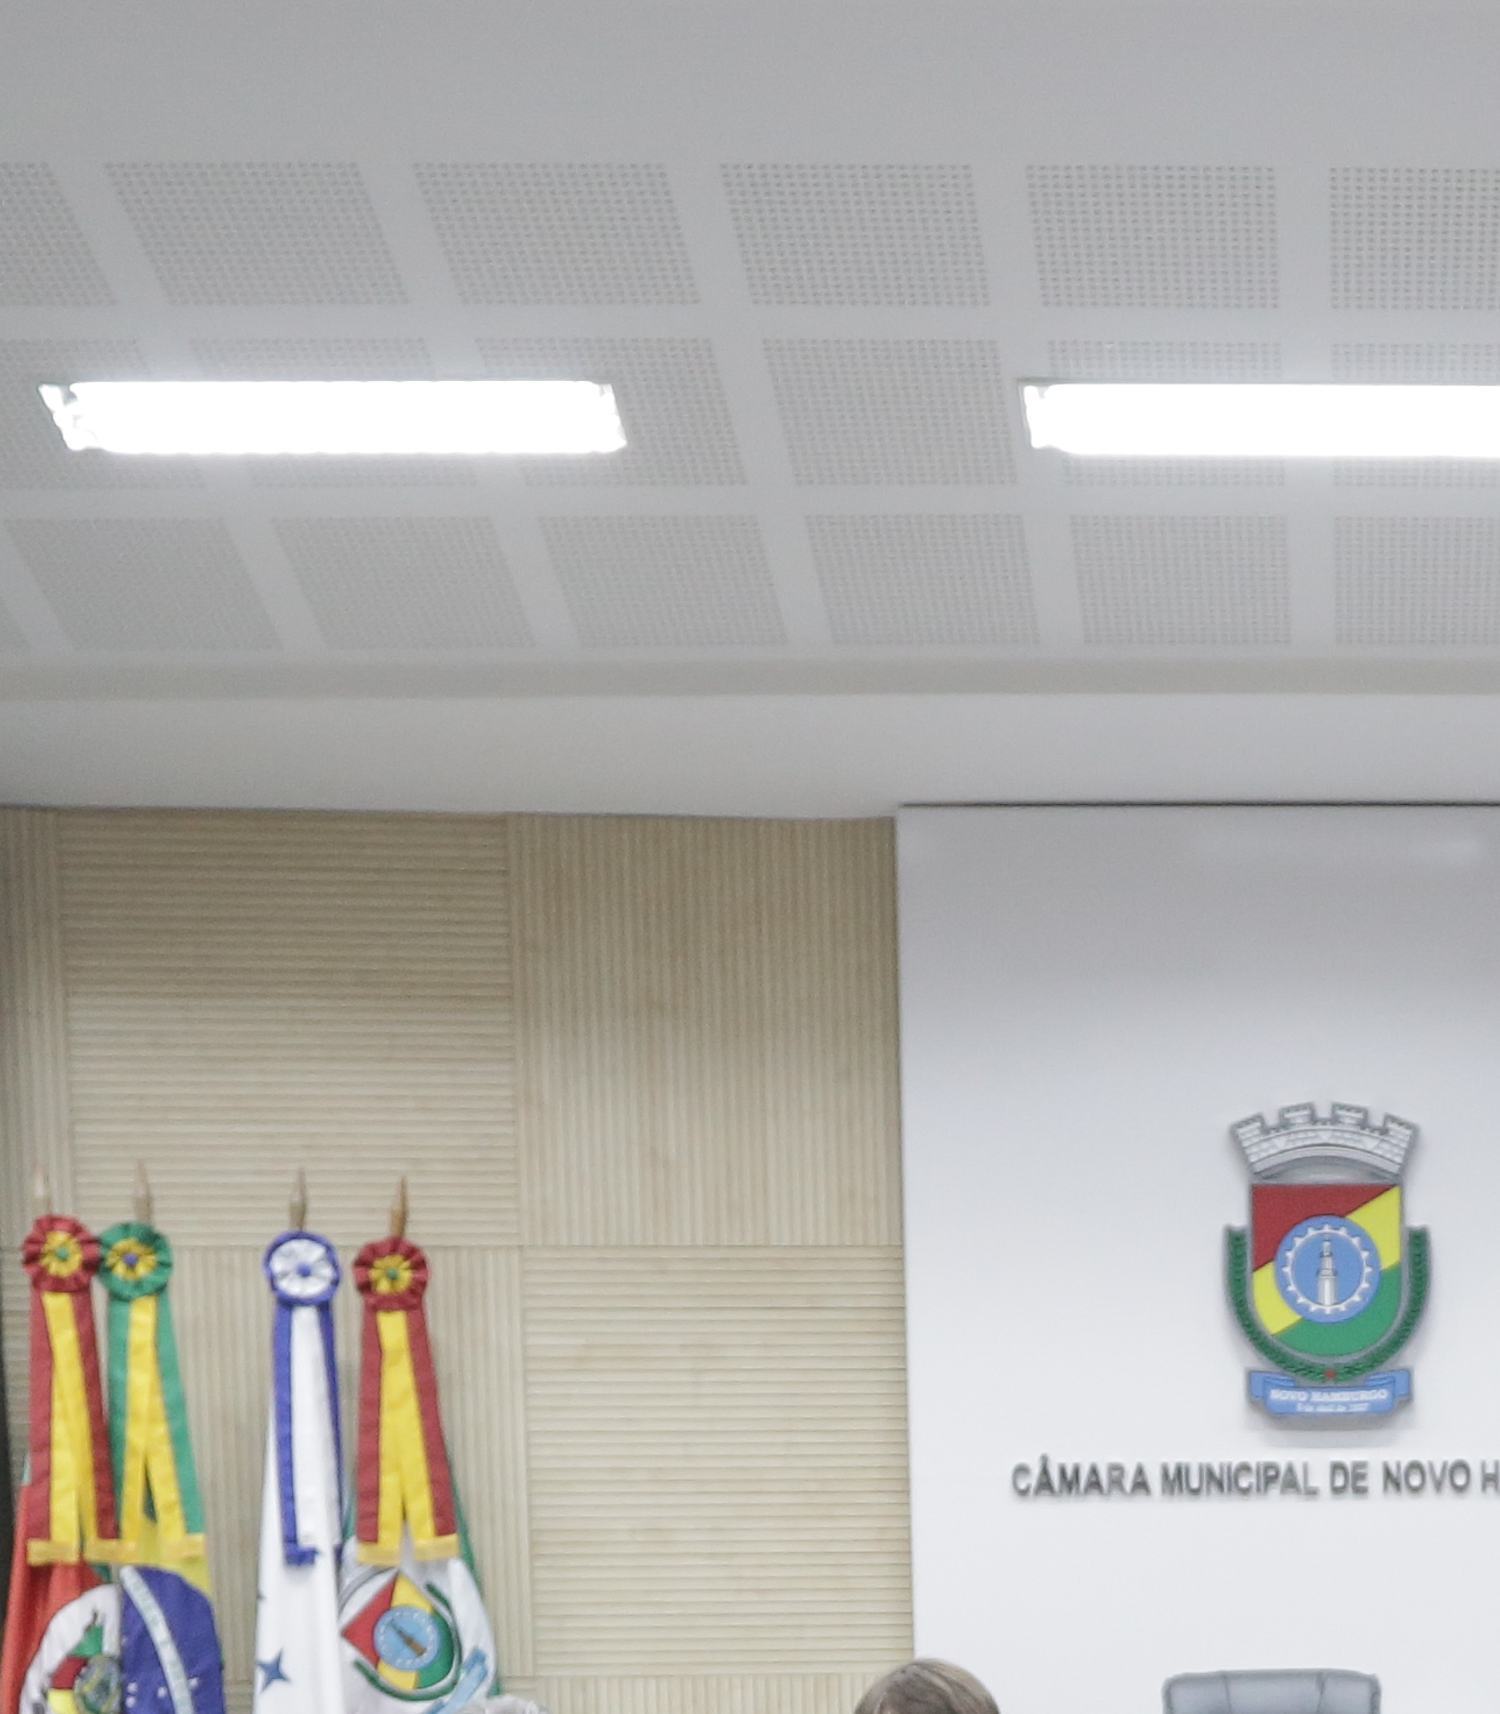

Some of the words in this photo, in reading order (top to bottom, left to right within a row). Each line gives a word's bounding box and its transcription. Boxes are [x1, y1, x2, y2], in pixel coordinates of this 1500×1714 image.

[1011, 1453, 1151, 1497] CÂMARA
[1160, 1460, 1319, 1496] MUNICIPAL
[1329, 1460, 1370, 1495] DE
[1382, 1459, 1471, 1495] NOVO
